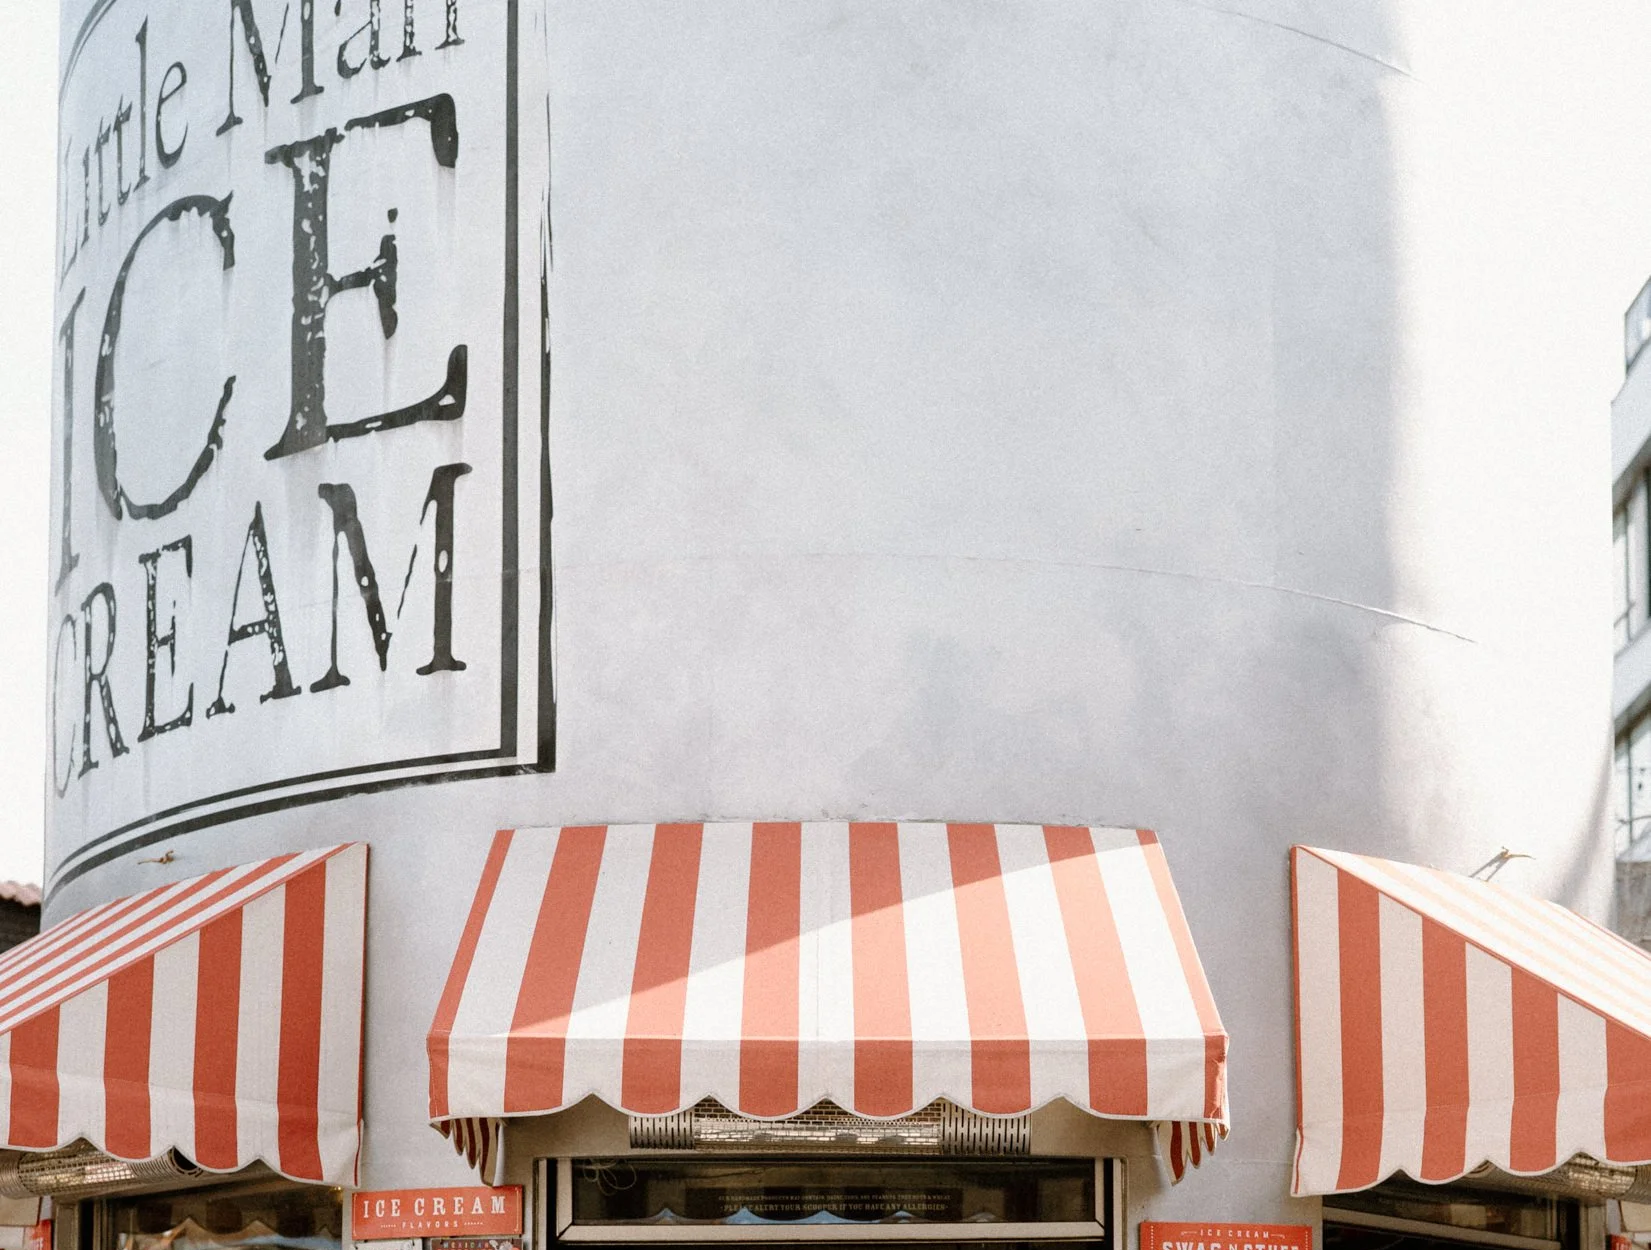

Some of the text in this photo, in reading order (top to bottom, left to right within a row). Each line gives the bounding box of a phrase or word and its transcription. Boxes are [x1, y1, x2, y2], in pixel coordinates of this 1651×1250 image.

[58, 14, 189, 291] Little
[55, 93, 468, 597] ICE
[52, 463, 472, 801] CREAM
[363, 1195, 506, 1219] ICE CREAM
[402, 1220, 460, 1229] FLAVORS
[1200, 1229, 1269, 1239] ICE CREAM
